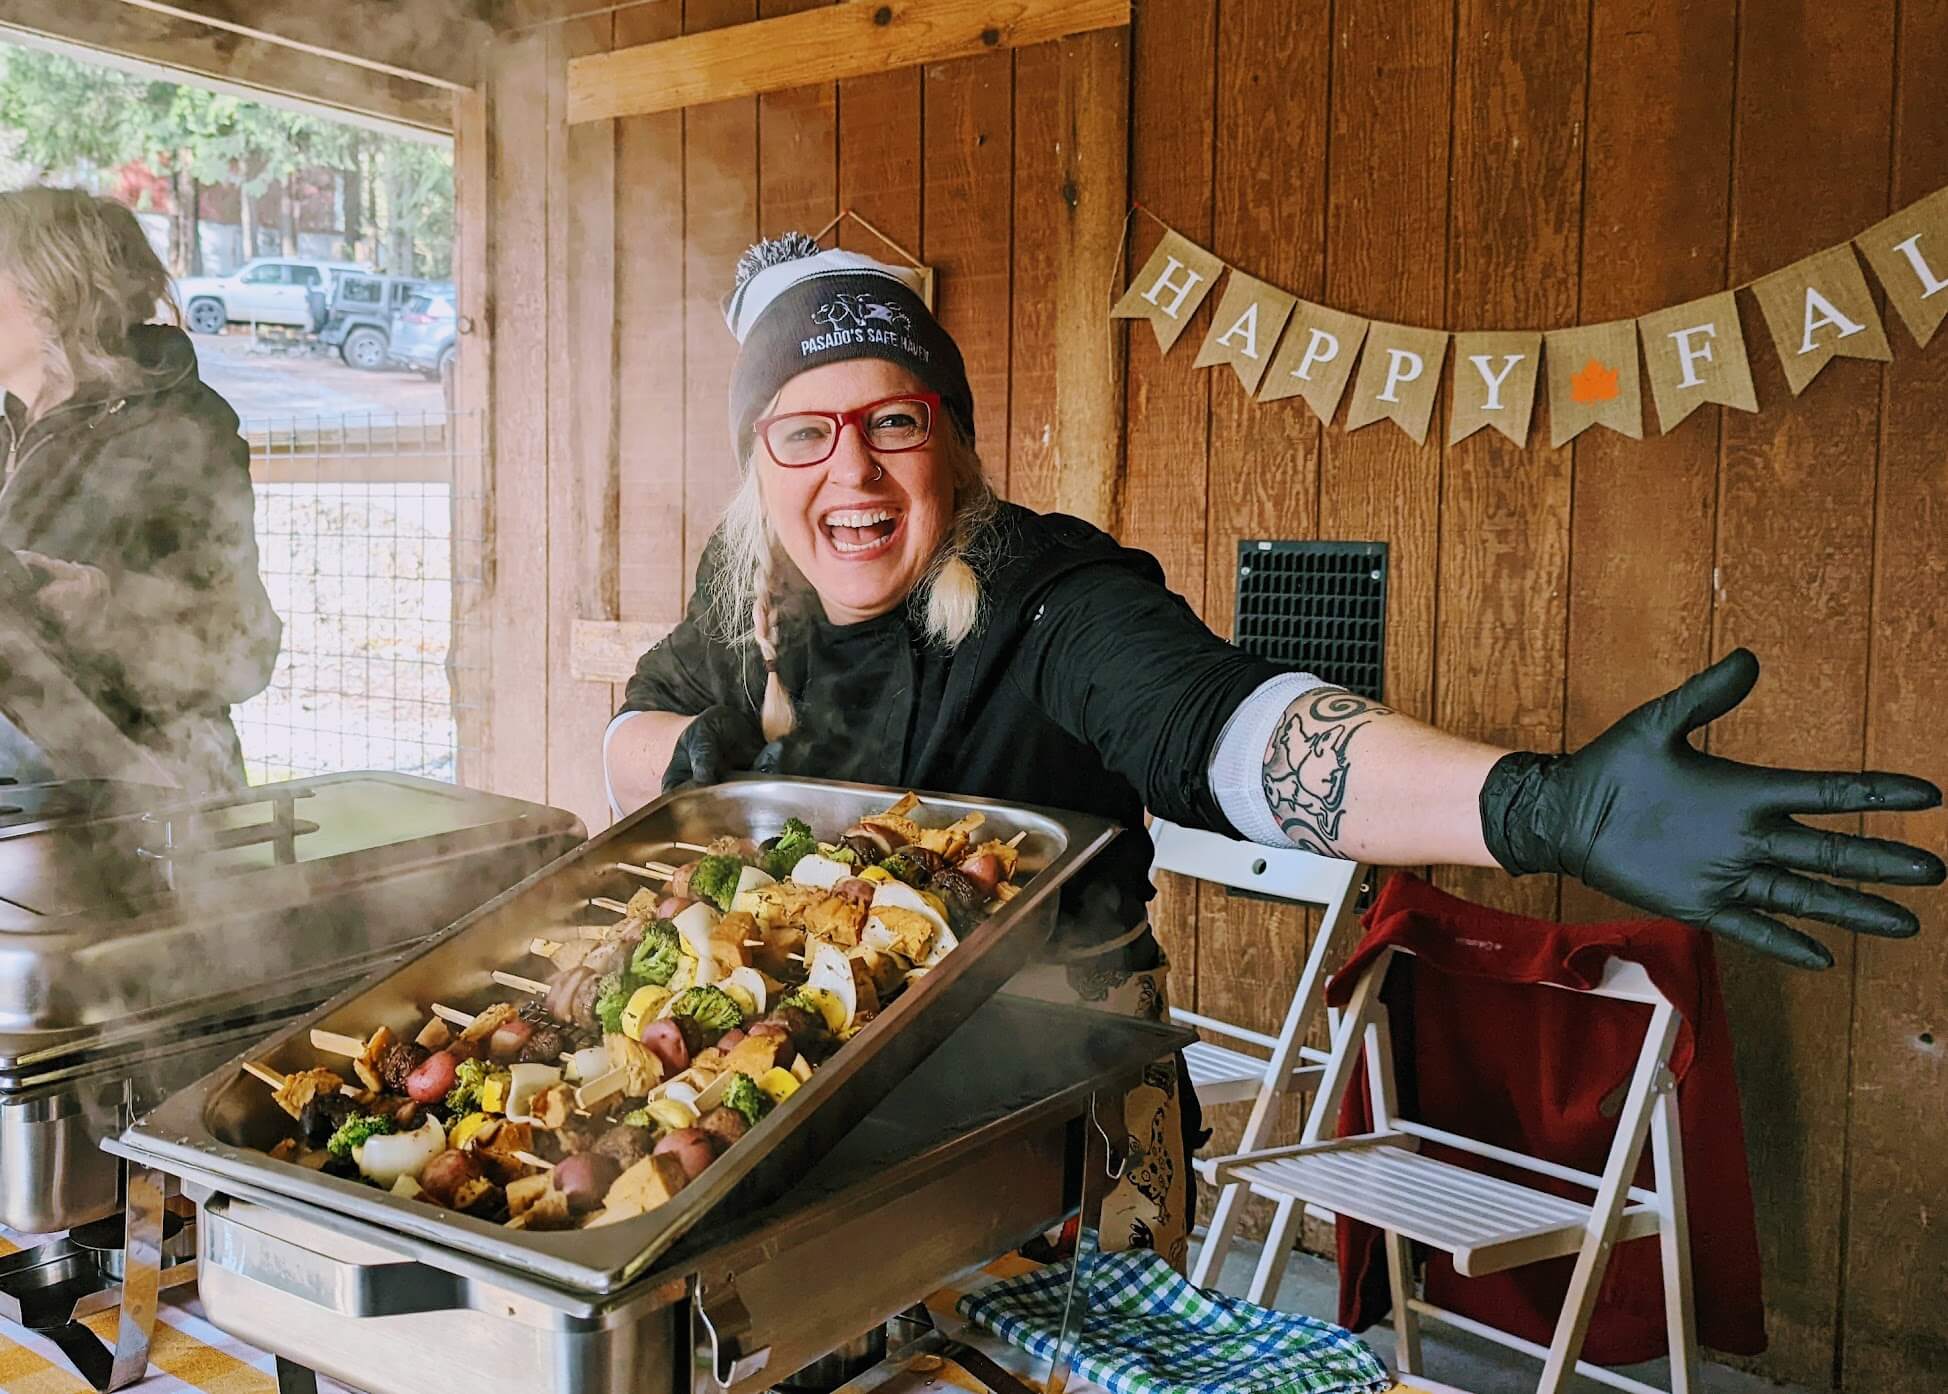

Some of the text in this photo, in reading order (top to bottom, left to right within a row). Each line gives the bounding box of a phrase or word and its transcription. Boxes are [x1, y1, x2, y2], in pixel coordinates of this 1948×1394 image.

[801, 328, 929, 362] PASADO'S SAFE HAVEN
[1141, 256, 1525, 410] HAPPY
